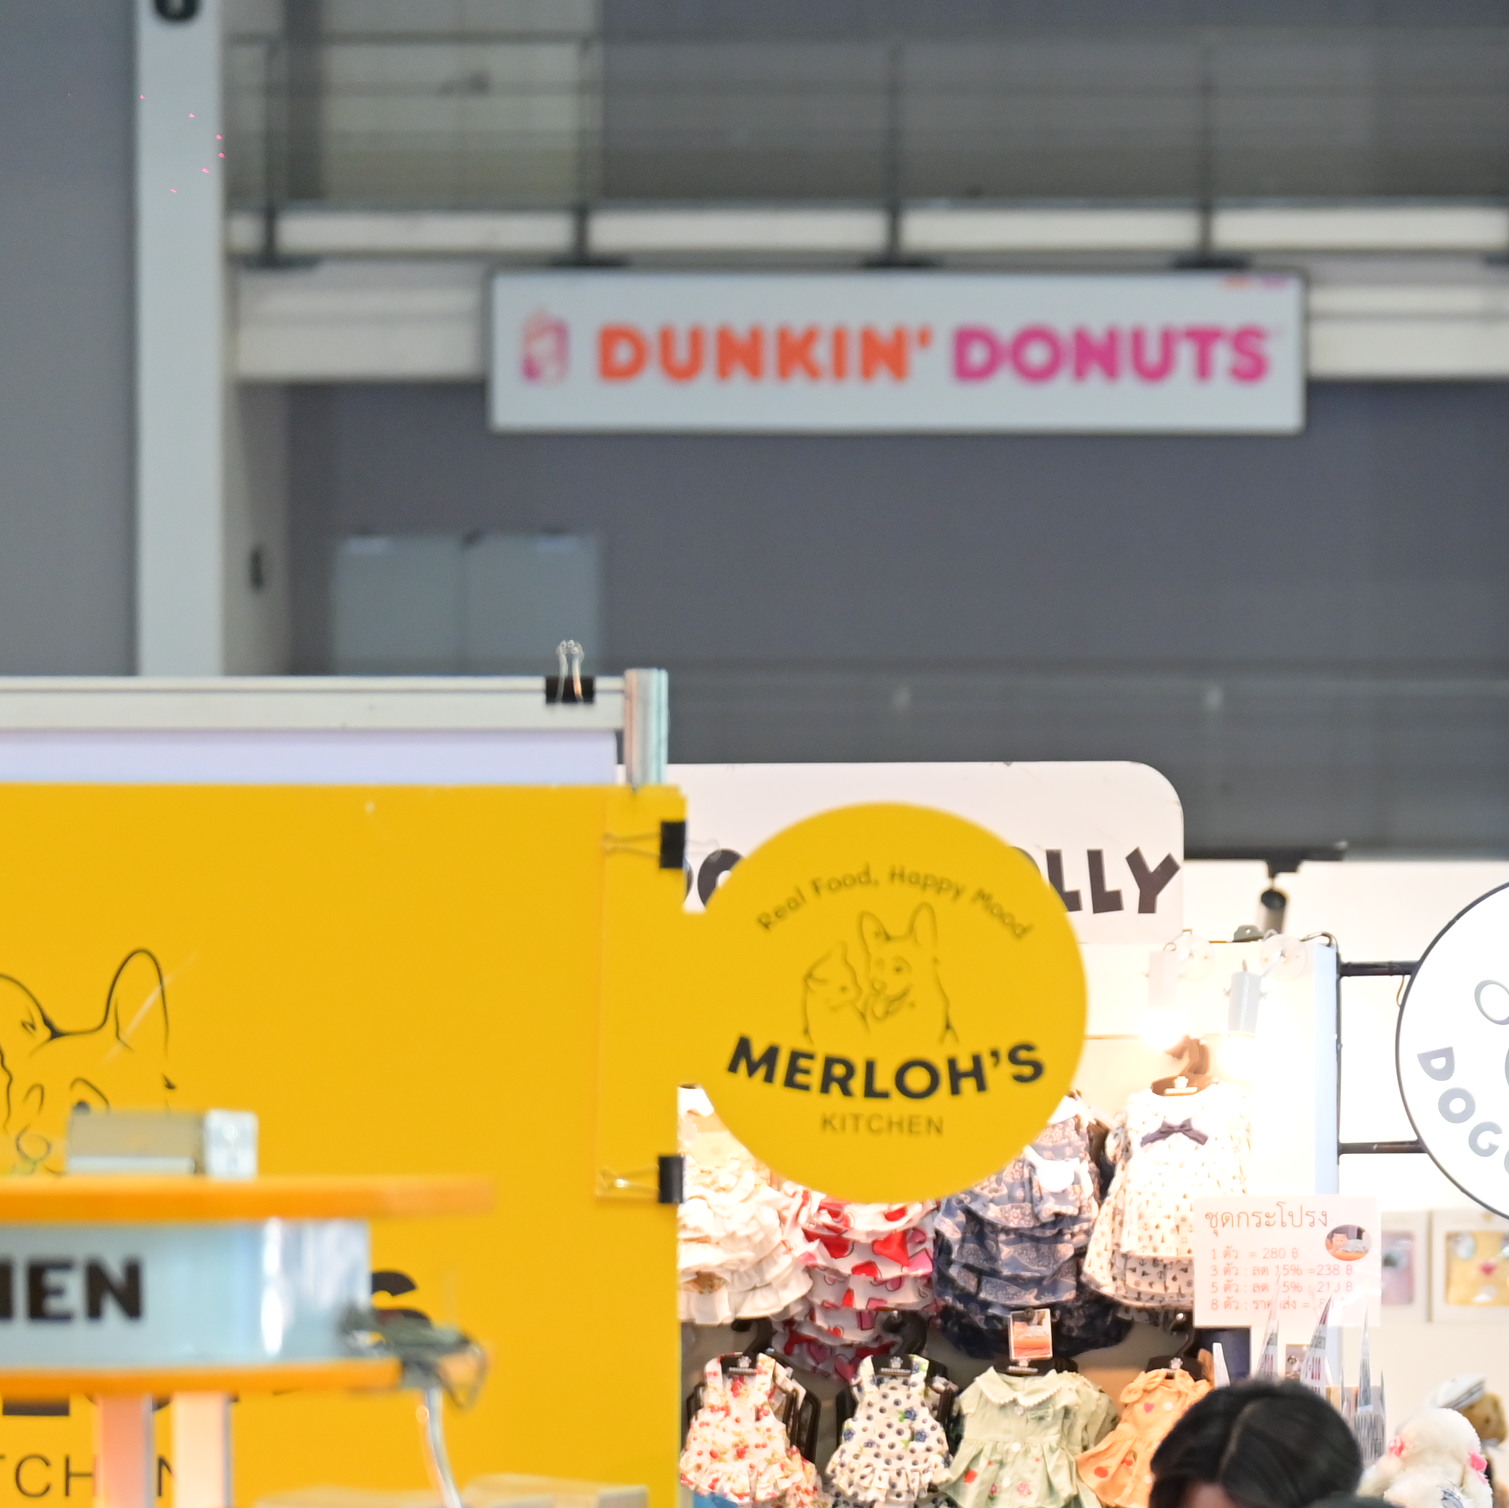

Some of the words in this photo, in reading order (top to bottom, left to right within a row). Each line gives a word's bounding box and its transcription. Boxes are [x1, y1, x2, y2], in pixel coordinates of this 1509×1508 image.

[599, 325, 932, 383] DUNKIN'
[953, 326, 1270, 384] DONUTS
[755, 886, 808, 933] Real
[889, 864, 967, 904] Happy
[974, 888, 1034, 940] Mood
[726, 1034, 1045, 1100] MERLOH'S
[820, 1113, 944, 1136] KITCHEN
[1204, 1201, 1328, 1237] ชุดกระโปรง
[1262, 1247, 1286, 1260] 280
